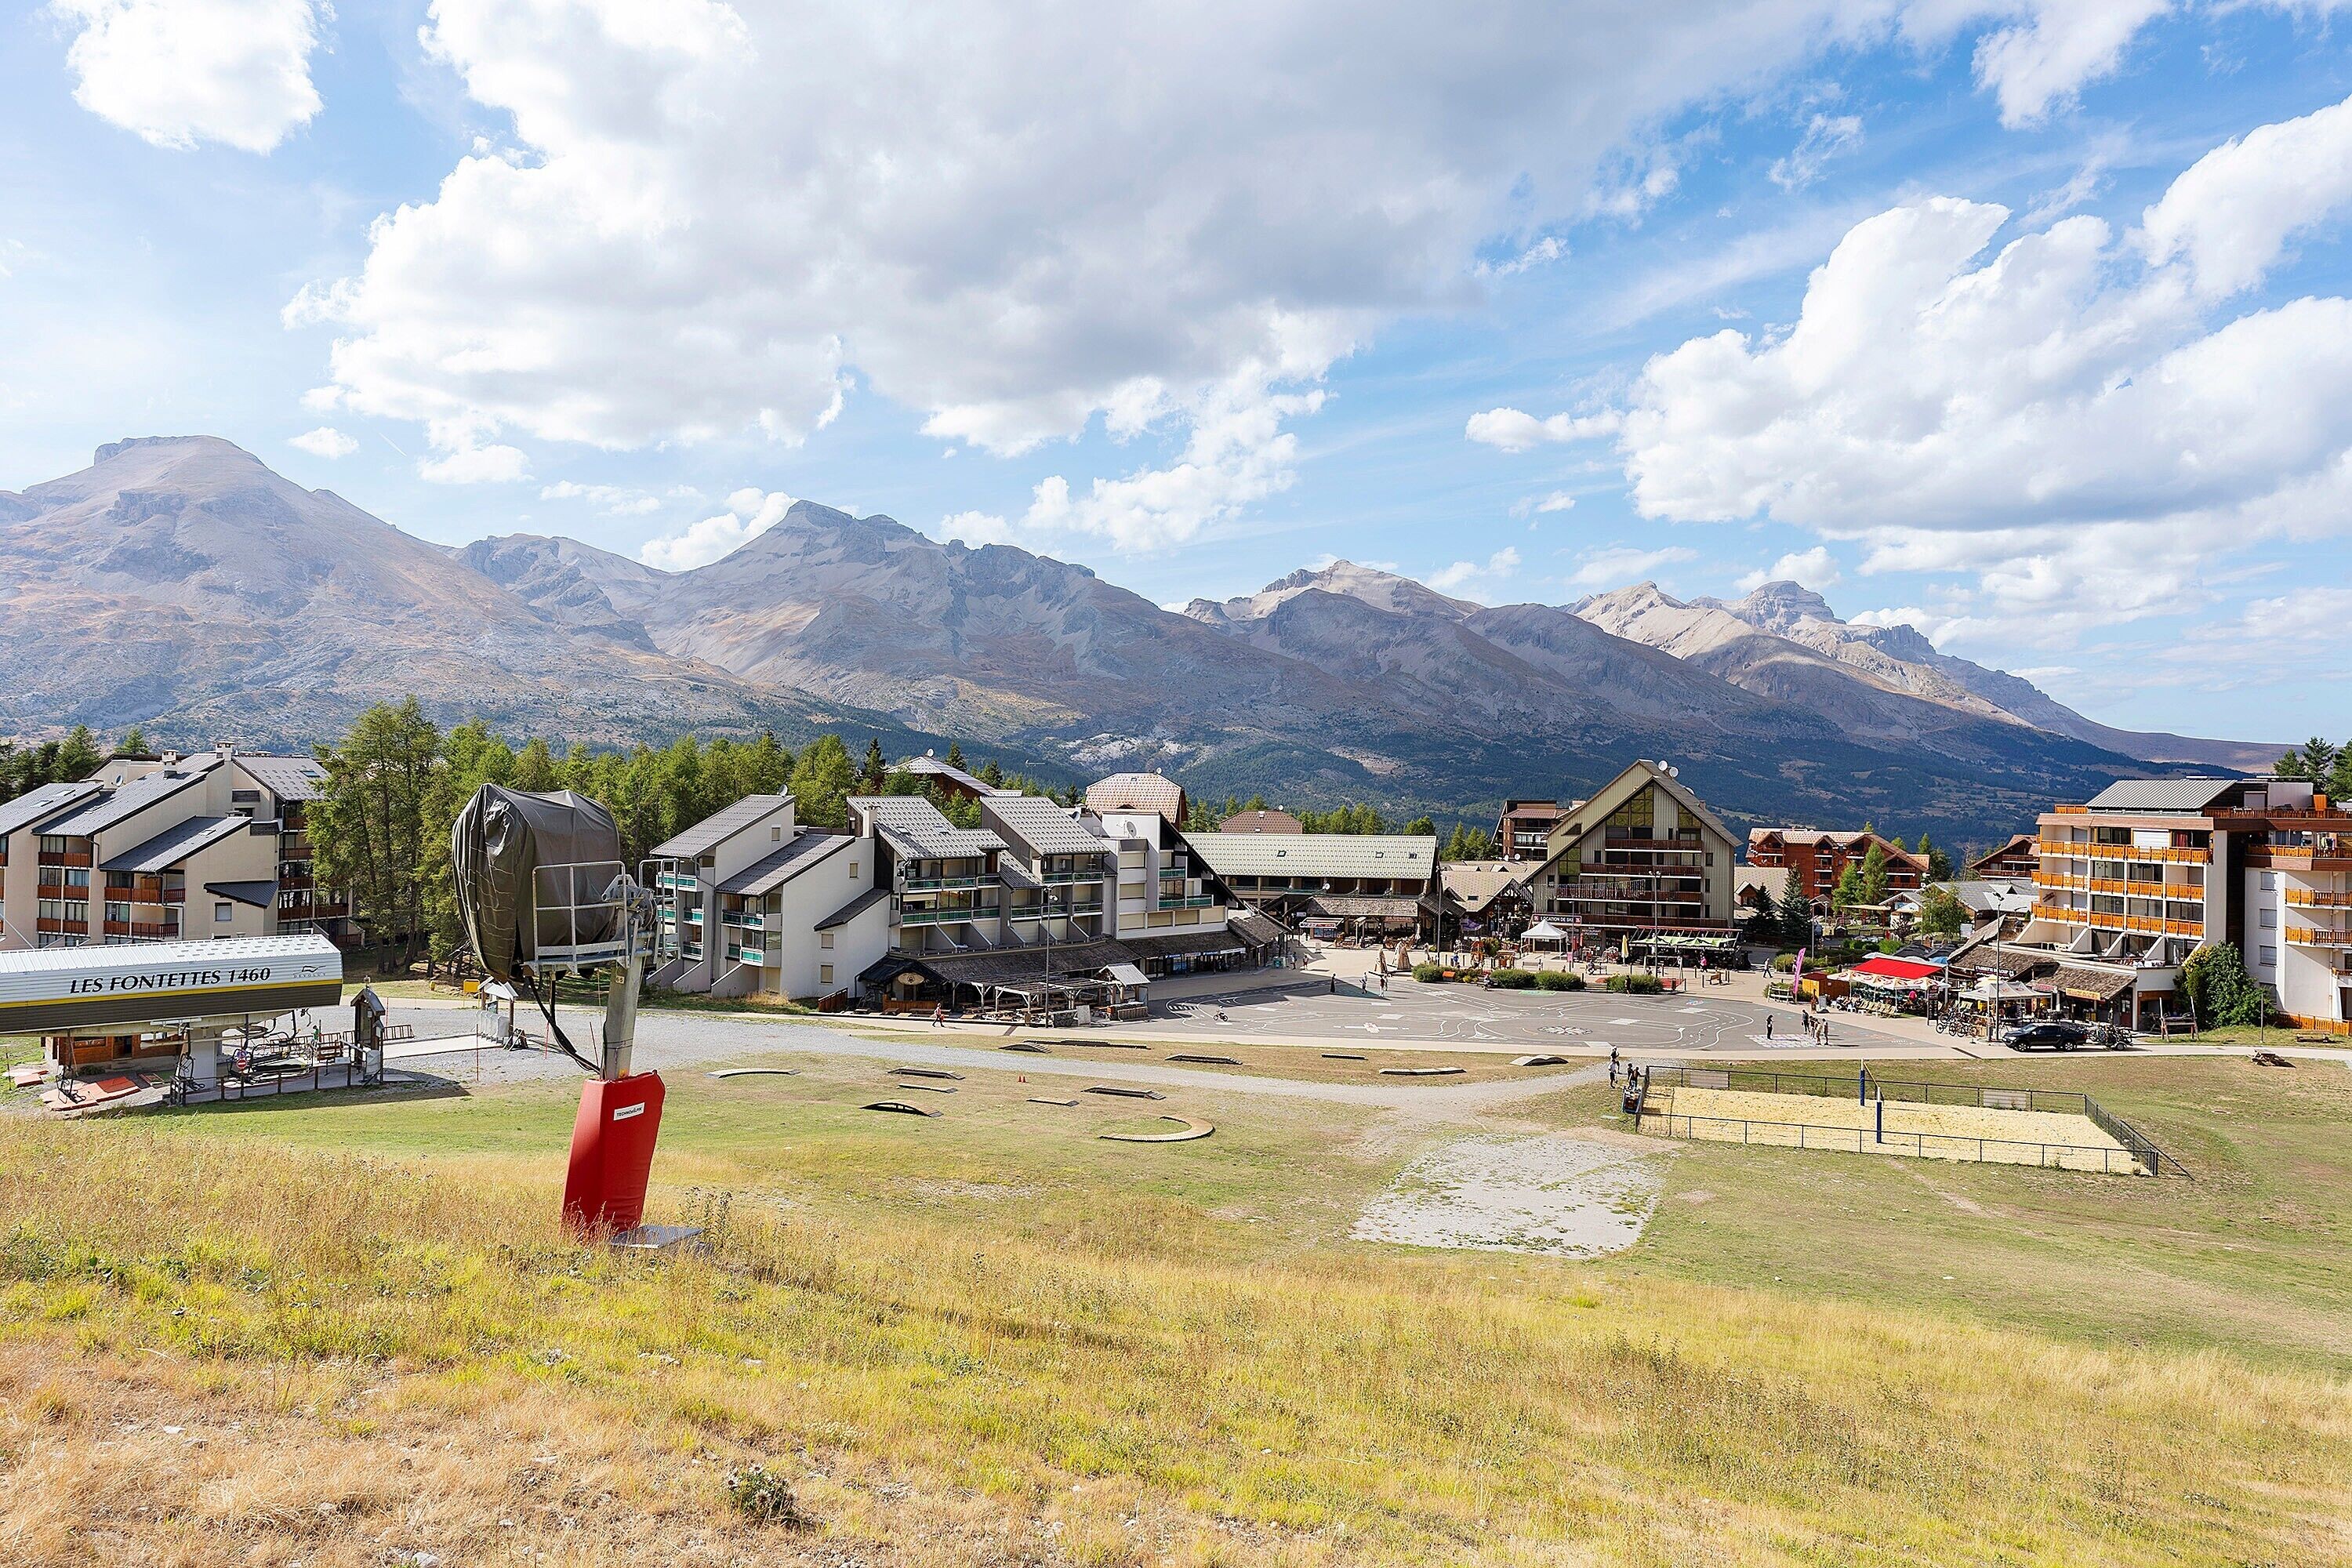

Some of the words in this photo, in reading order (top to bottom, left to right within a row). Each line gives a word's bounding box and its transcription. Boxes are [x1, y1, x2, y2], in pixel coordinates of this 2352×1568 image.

[71, 978, 103, 994] LES
[110, 970, 221, 991] FONTETTES
[228, 967, 270, 983] 1460
